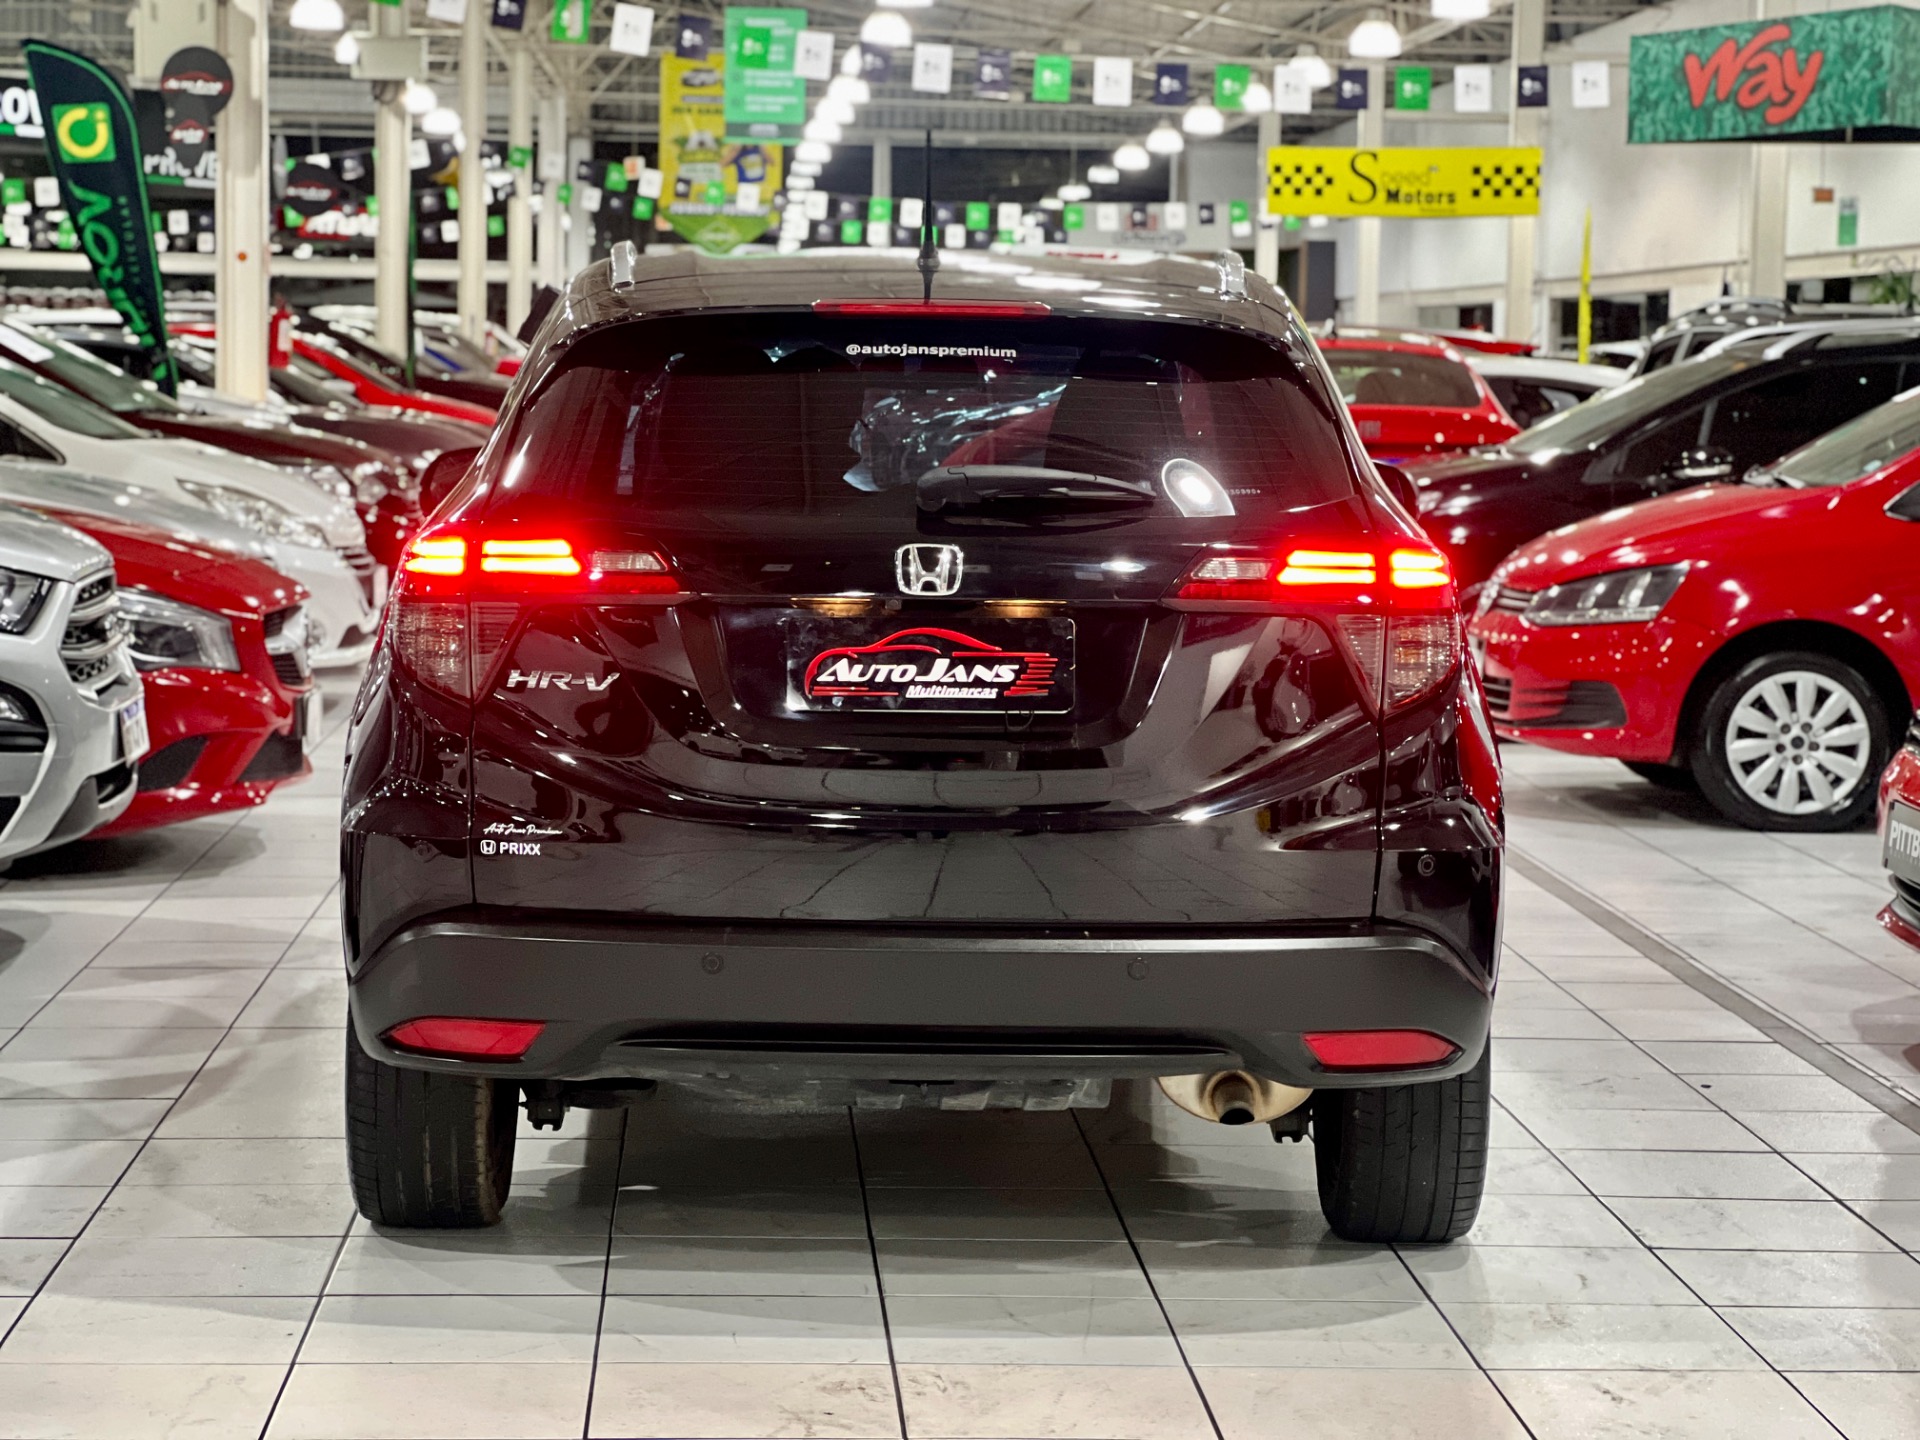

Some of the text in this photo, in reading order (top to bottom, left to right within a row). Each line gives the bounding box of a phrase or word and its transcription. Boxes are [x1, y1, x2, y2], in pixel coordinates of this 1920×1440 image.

[1684, 24, 1824, 124] Way
[1386, 188, 1457, 205] Motors
[845, 343, 1017, 358] @autojanspremium
[507, 669, 621, 692] HR-V
[906, 685, 998, 698] Multimarcas
[499, 842, 541, 856] PRIXX
